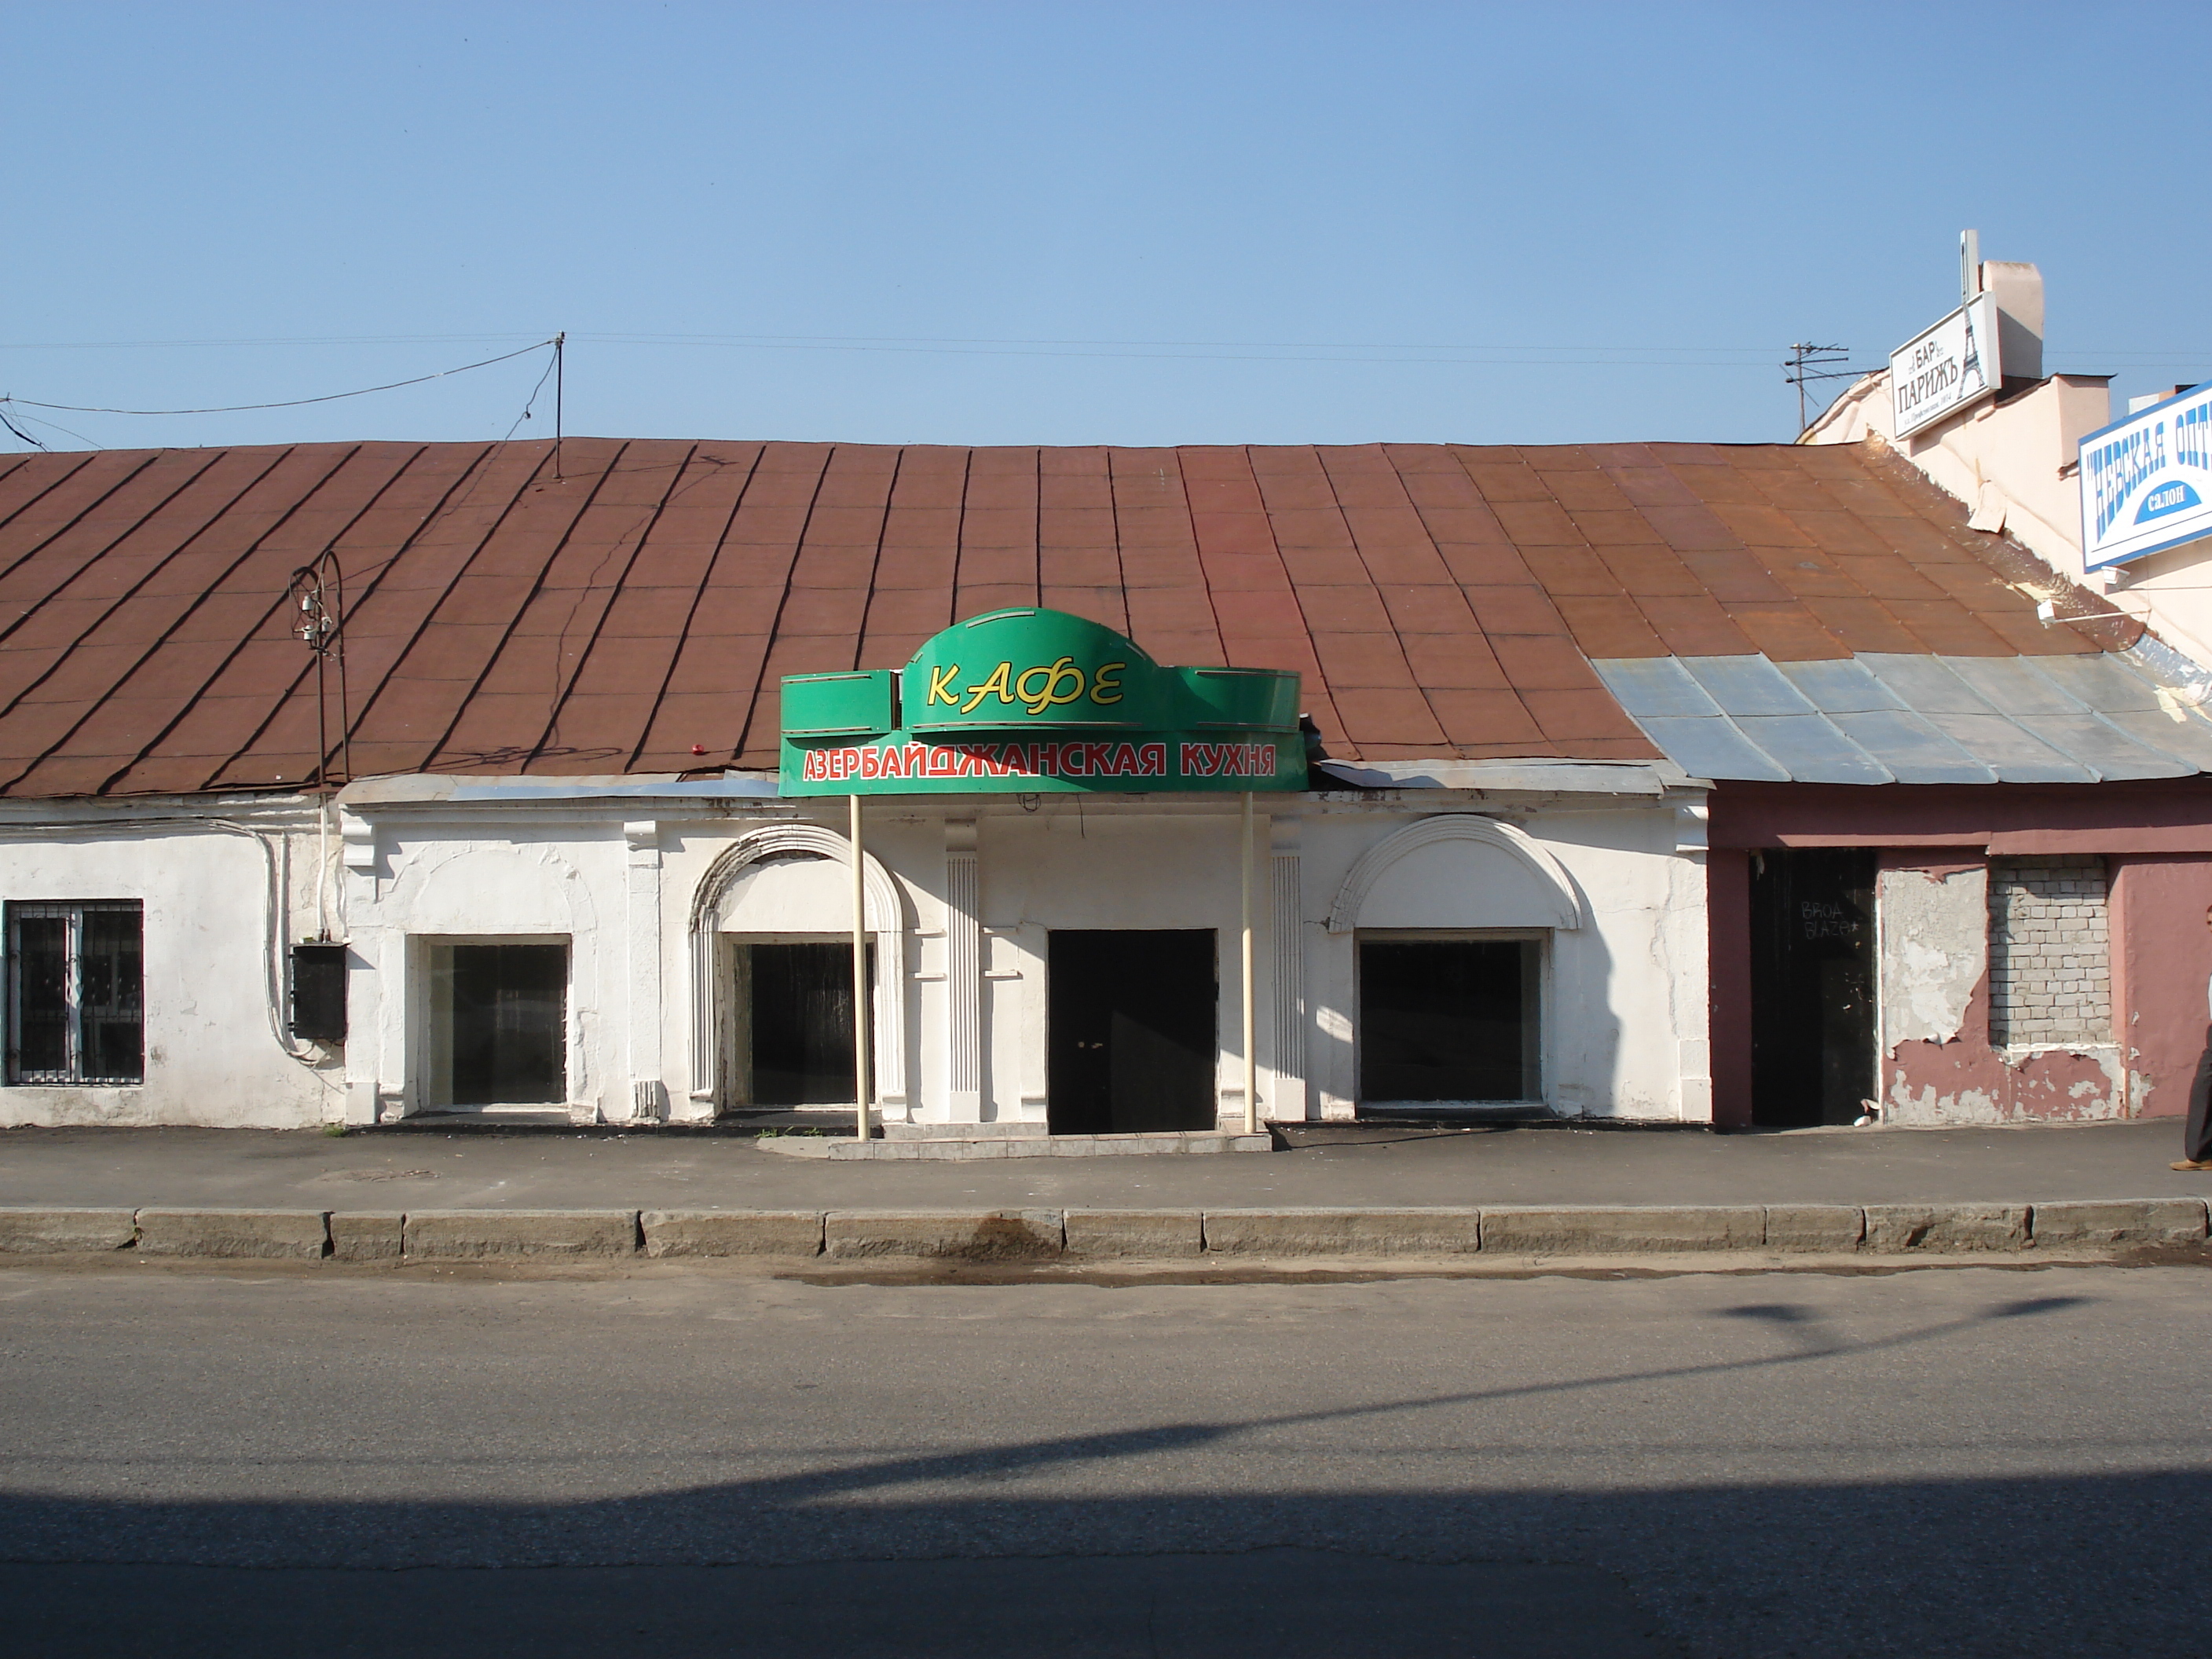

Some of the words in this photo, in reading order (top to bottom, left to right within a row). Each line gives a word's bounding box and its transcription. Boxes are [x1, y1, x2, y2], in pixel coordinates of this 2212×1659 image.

[1915, 341, 1936, 369] БАР
[1898, 356, 1958, 414] ПАРИЖЪ
[2176, 401, 2212, 473] ОПТ
[2148, 485, 2185, 512] салон
[927, 657, 1126, 715] КАФЕ
[803, 741, 1166, 782] АЗЕРБАЙДЖАНСКАЯ
[1181, 743, 1276, 777] КУХНЯ
